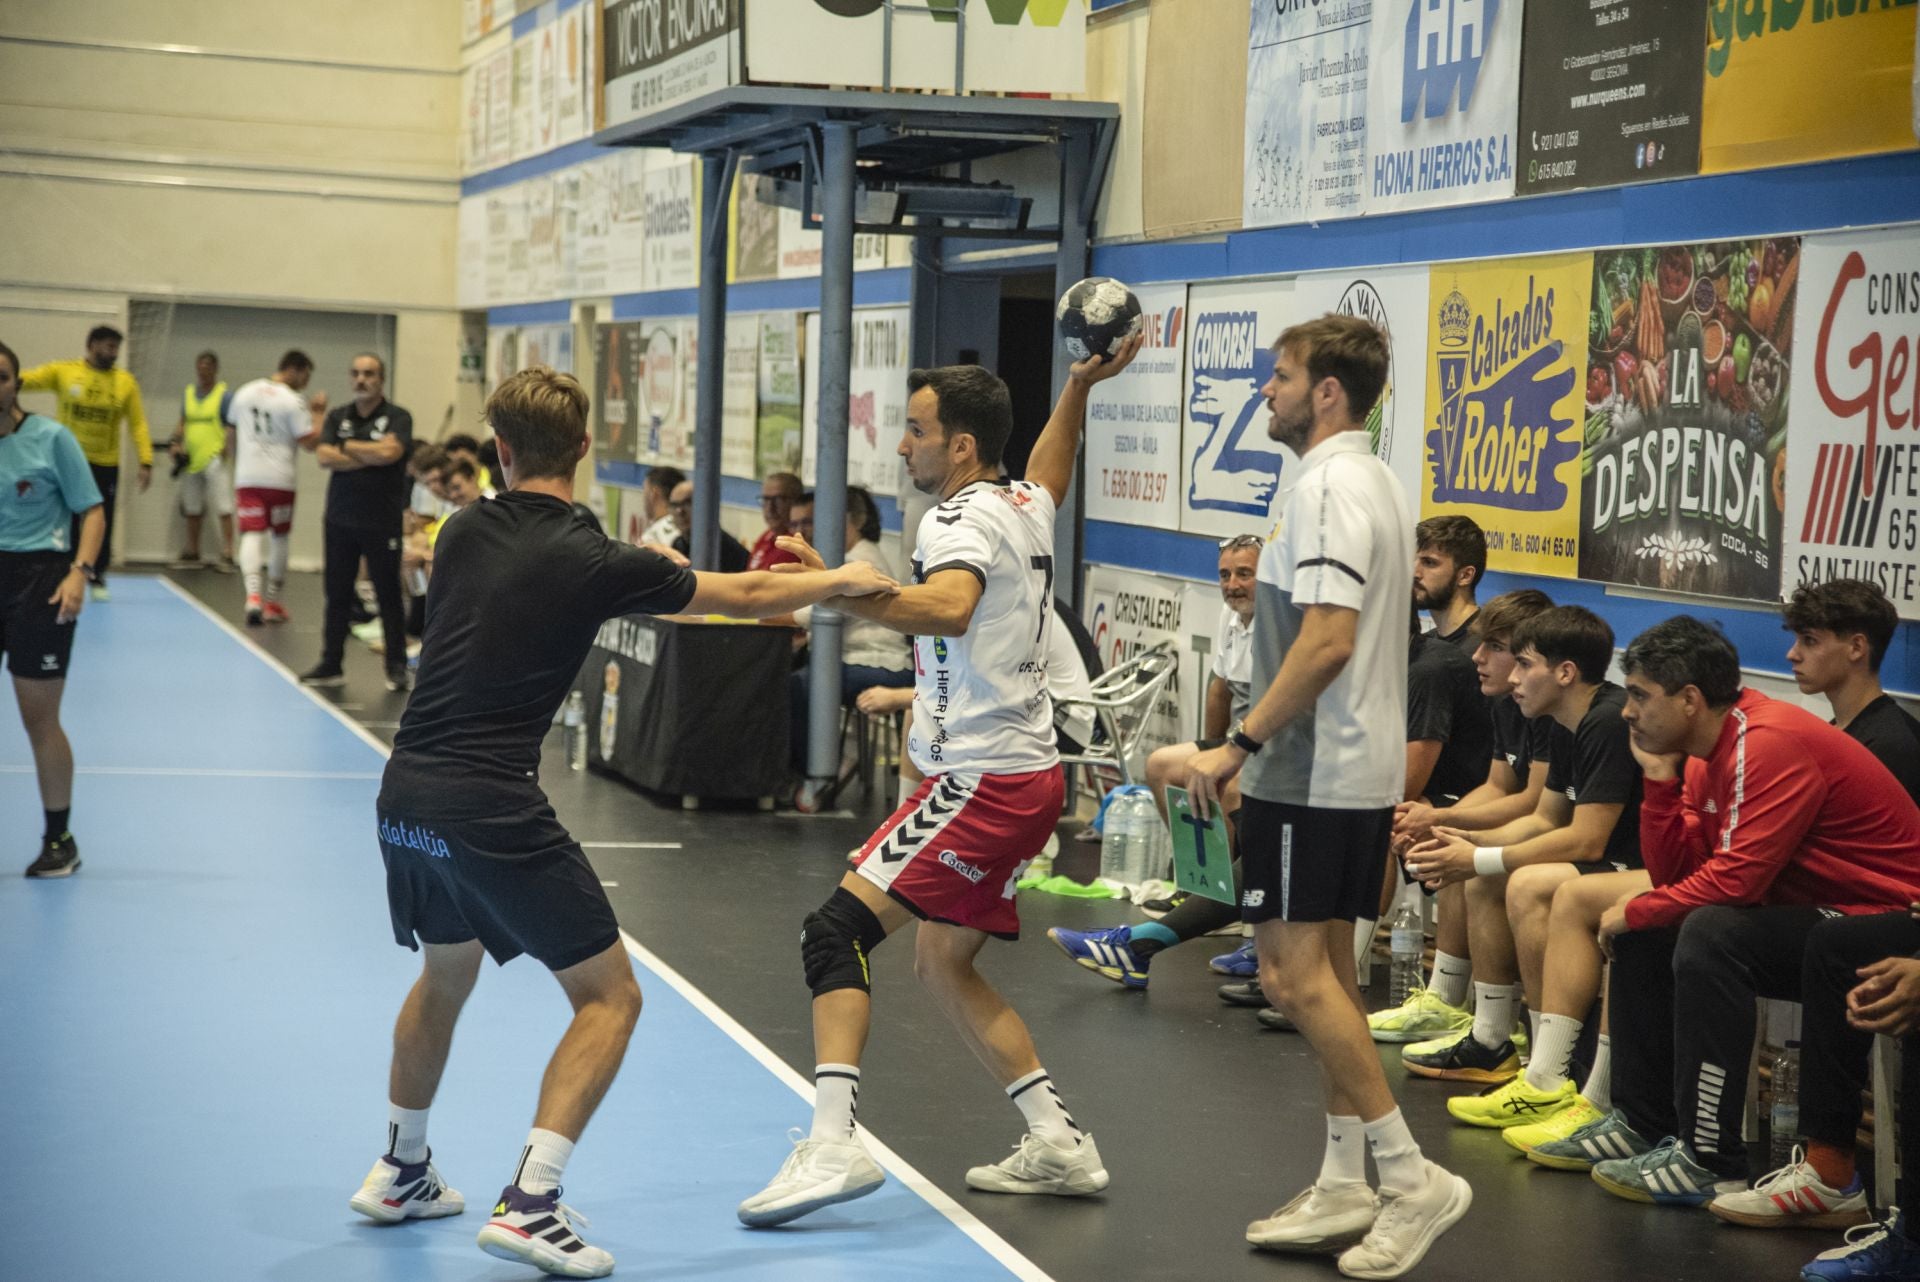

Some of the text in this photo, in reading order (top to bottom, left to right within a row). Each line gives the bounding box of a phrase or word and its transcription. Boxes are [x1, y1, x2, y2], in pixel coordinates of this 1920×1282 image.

[617, 0, 662, 69] VICTOR
[1299, 47, 1368, 87] Javier Vicente Rebollo
[1373, 133, 1512, 197] HONA HIERROS S.A.
[1540, 135, 1553, 151] 921
[1194, 320, 1255, 370] CONORSA
[1471, 275, 1554, 386] Calzados
[1670, 348, 1699, 405] LA
[1454, 396, 1549, 495] Rober
[1102, 468, 1168, 504] T. 636 00 23 97
[1592, 426, 1769, 545] DESPENSA
[1484, 527, 1576, 558] CIÓN Tel. 600 41 65 00
[1721, 532, 1748, 558] COCA
[1754, 553, 1769, 570] SG
[1030, 555, 1054, 644] 7
[1114, 591, 1182, 633] CRISTALERÍA
[935, 669, 949, 713] HIPER
